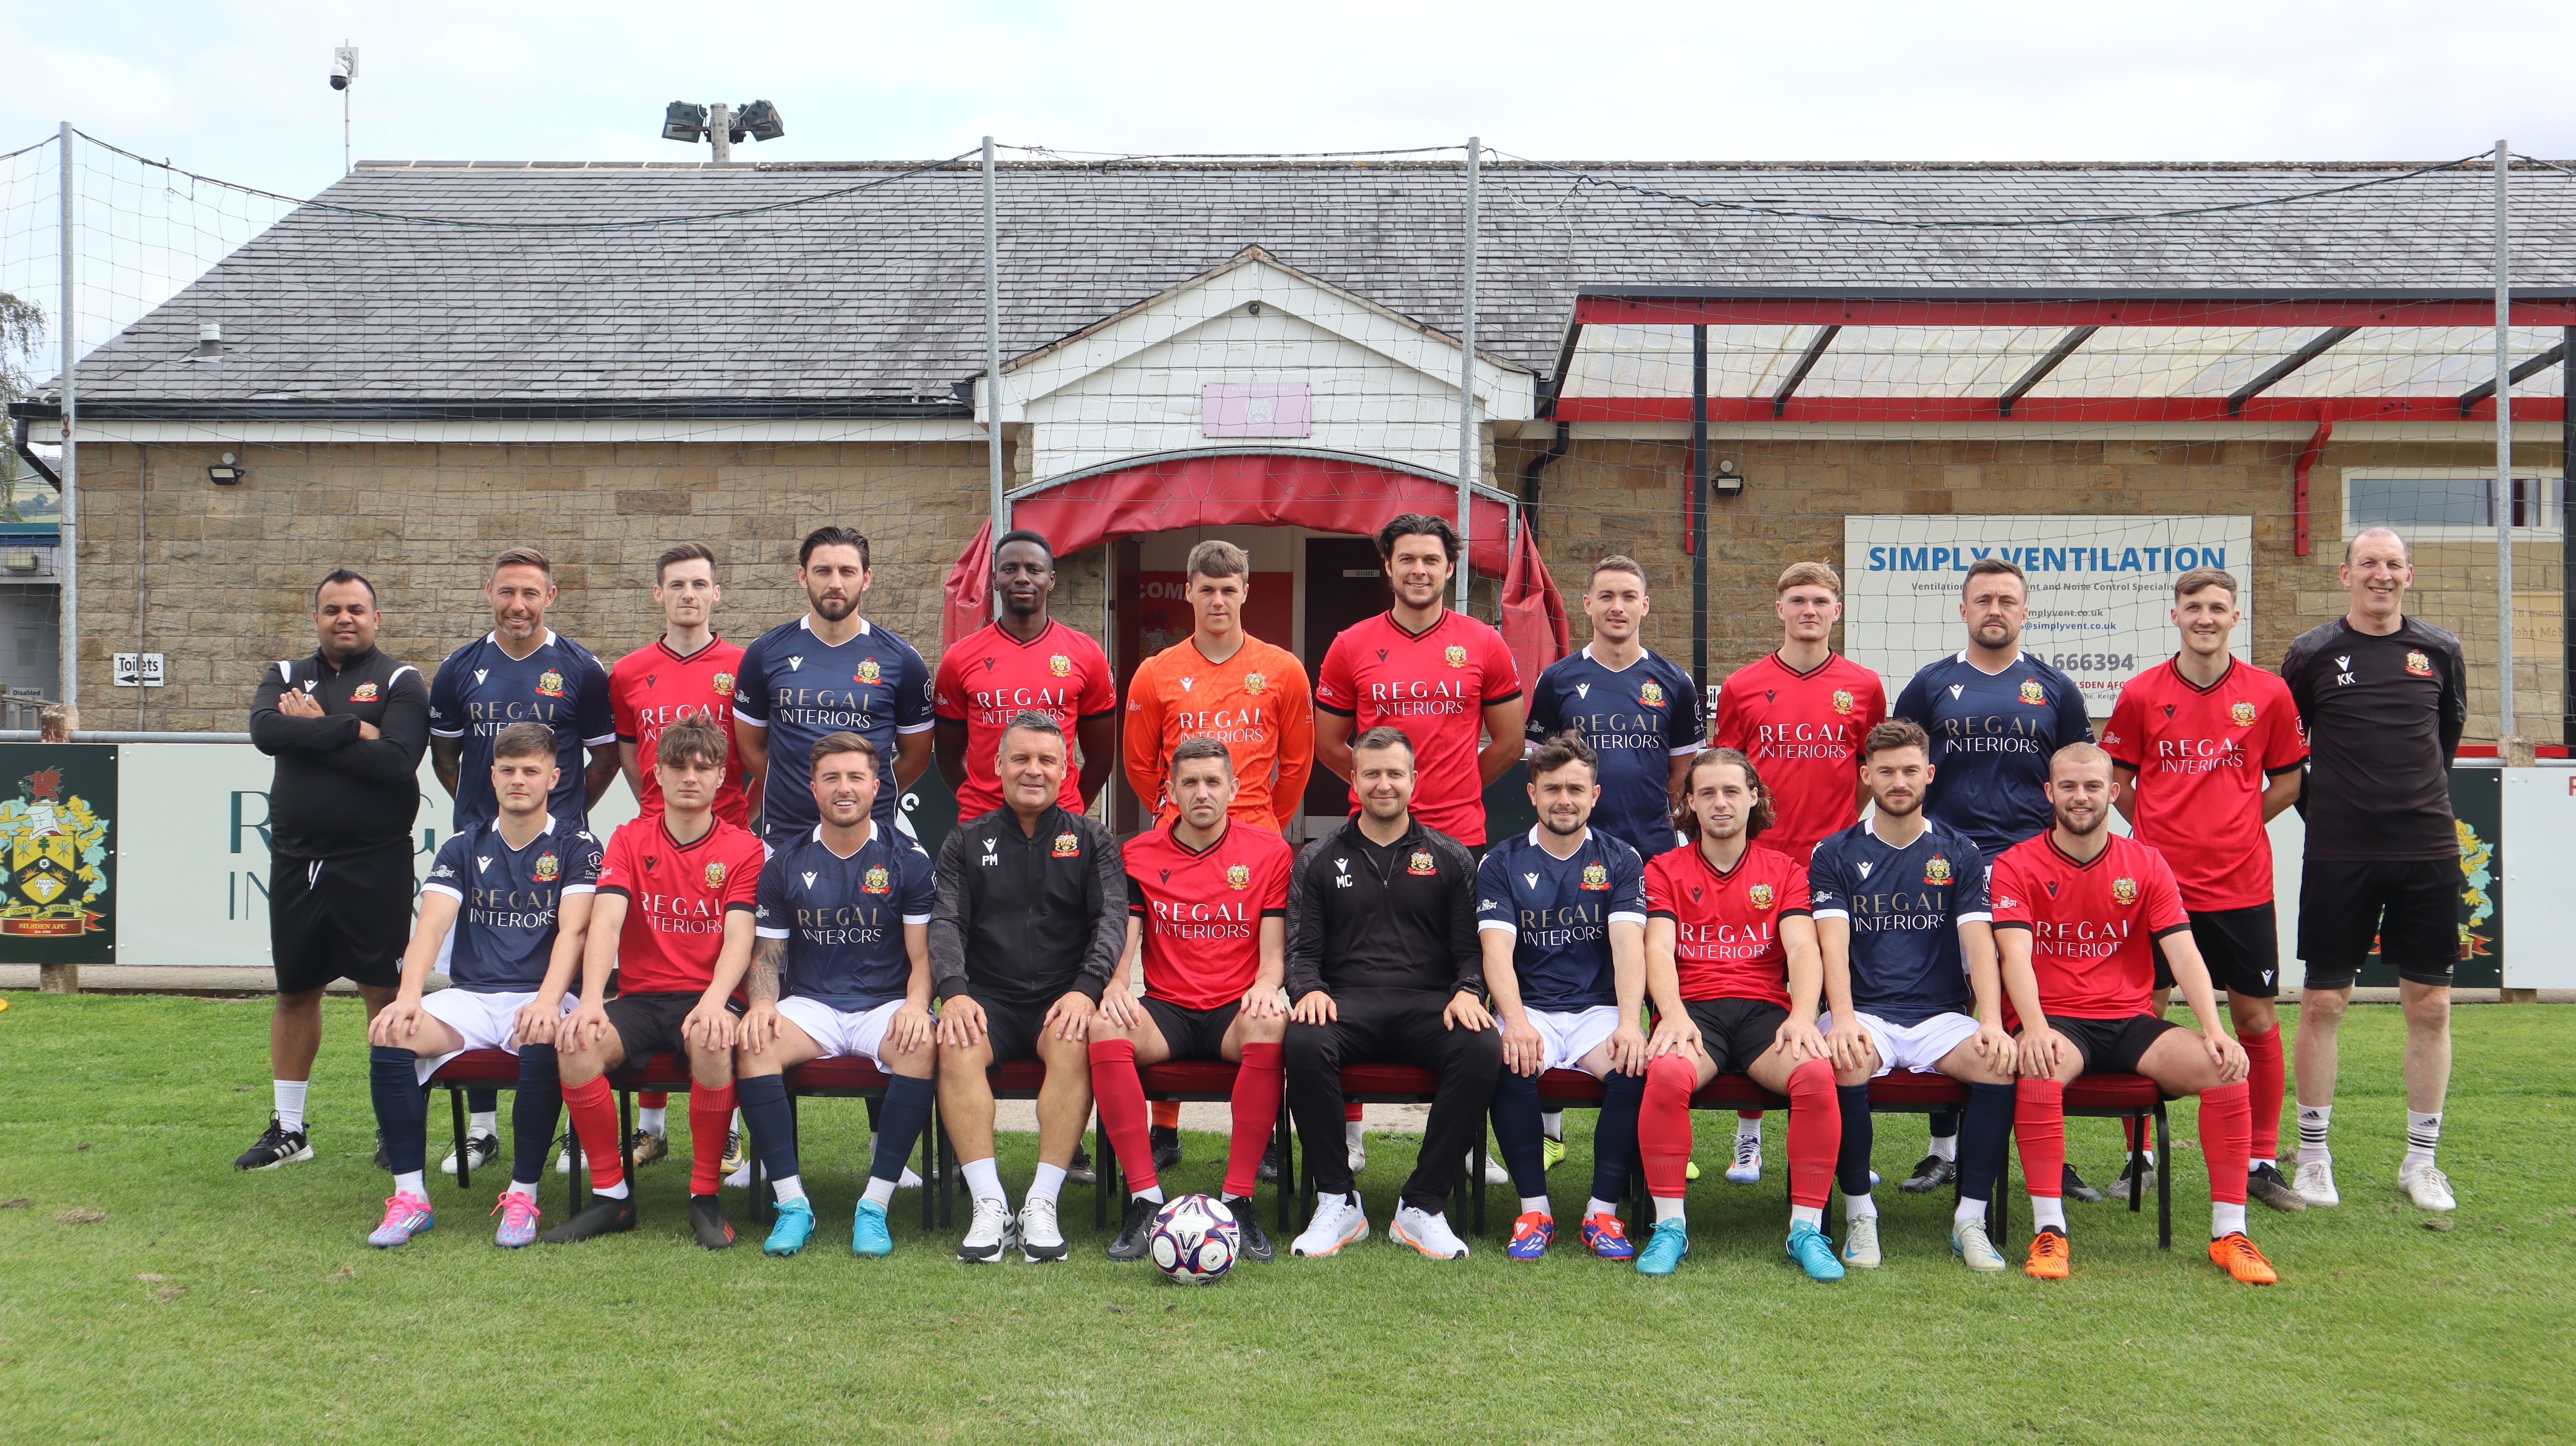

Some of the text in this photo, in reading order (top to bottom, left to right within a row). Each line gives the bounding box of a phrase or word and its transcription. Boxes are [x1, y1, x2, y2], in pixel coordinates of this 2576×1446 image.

[1869, 547, 2225, 571] SIMPLY VENTILATION
[2064, 583, 2091, 591] Noise
[2094, 583, 2129, 591] Control
[2132, 583, 2175, 592] Specialis
[2028, 609, 2103, 618] mplyvent.co.uk
[2020, 622, 2116, 632] s@simplyvent.co.uk
[118, 657, 158, 672] Toilets
[2053, 653, 2134, 671] 666394
[2336, 671, 2356, 686] KK
[780, 688, 874, 713] REGAL
[976, 687, 1066, 708] REGAL
[1372, 680, 1467, 701] REGAL
[470, 701, 559, 722] REGAL
[641, 703, 729, 726] REGAL
[1179, 708, 1264, 729] REGAL
[1375, 700, 1465, 717] INTERIORS
[780, 709, 871, 729] INTERIORS
[1572, 714, 1660, 733] REGAL
[1944, 716, 2040, 738] REGAL
[1579, 734, 1661, 749] NTERIORS
[1759, 723, 1847, 743] REGAL
[1759, 744, 1847, 759] INTERIORS
[1946, 737, 2039, 754] INTERIORS
[982, 853, 998, 866] PM
[1336, 874, 1353, 889] MC
[471, 887, 556, 909] REGAL
[1853, 891, 1949, 914] REGAL
[35, 913, 49, 921] AND
[469, 908, 557, 928] INTERIORS
[797, 907, 884, 927] REGAL
[1153, 900, 1251, 922] REGAL
[1521, 904, 1605, 929] REGAL
[1155, 919, 1250, 939] INTERIORS
[1680, 922, 1774, 943] REGAL
[1854, 913, 1946, 932] INTERIORS
[1678, 942, 1774, 959] INTERIORS
